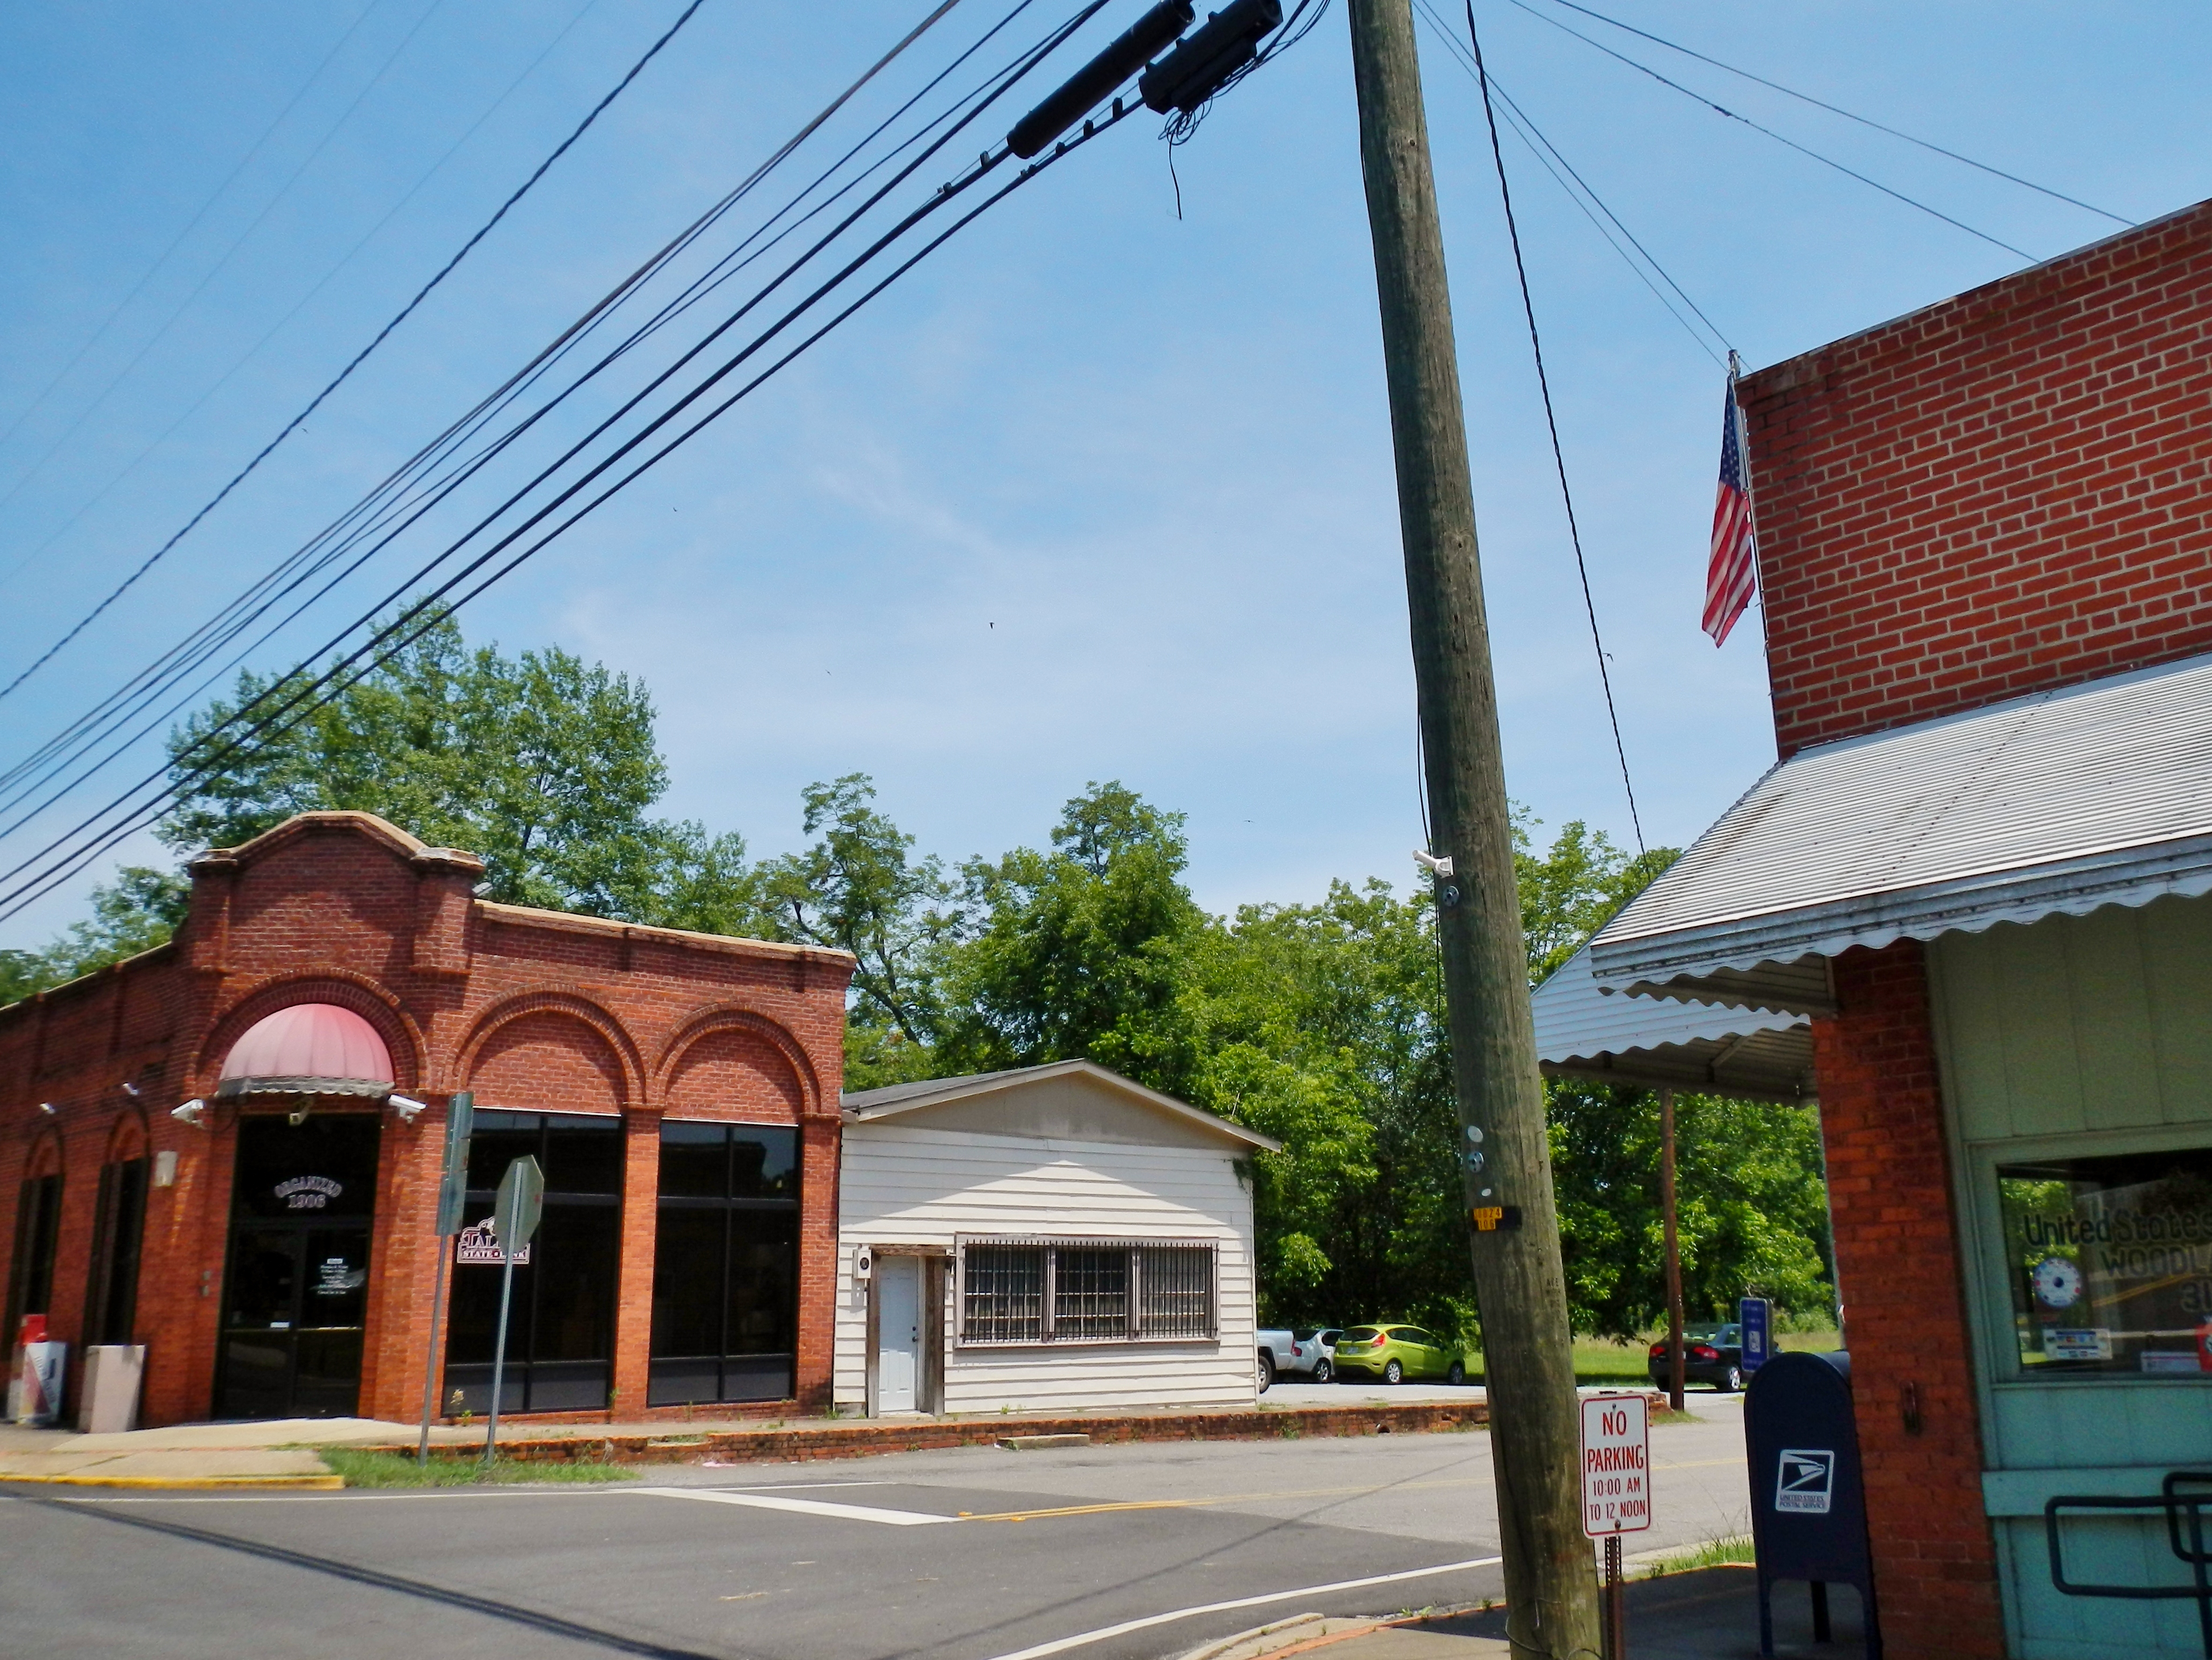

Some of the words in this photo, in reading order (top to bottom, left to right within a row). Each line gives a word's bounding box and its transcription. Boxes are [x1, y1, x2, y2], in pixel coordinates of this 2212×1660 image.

[274, 1175, 342, 1198] ORGANIZED
[288, 1194, 326, 1208] 1906
[2023, 1208, 2112, 1246] United
[2114, 1205, 2212, 1243] States
[463, 1232, 501, 1249] TAL
[2101, 1245, 2212, 1278] WOODL
[1602, 1410, 1627, 1436] NO
[1587, 1444, 1644, 1473] PARKING
[1593, 1477, 1621, 1496] 10:00
[1627, 1476, 1641, 1493] AM
[1589, 1503, 1601, 1521] TO
[1606, 1502, 1615, 1519] 12
[1620, 1499, 1646, 1518] NOON
